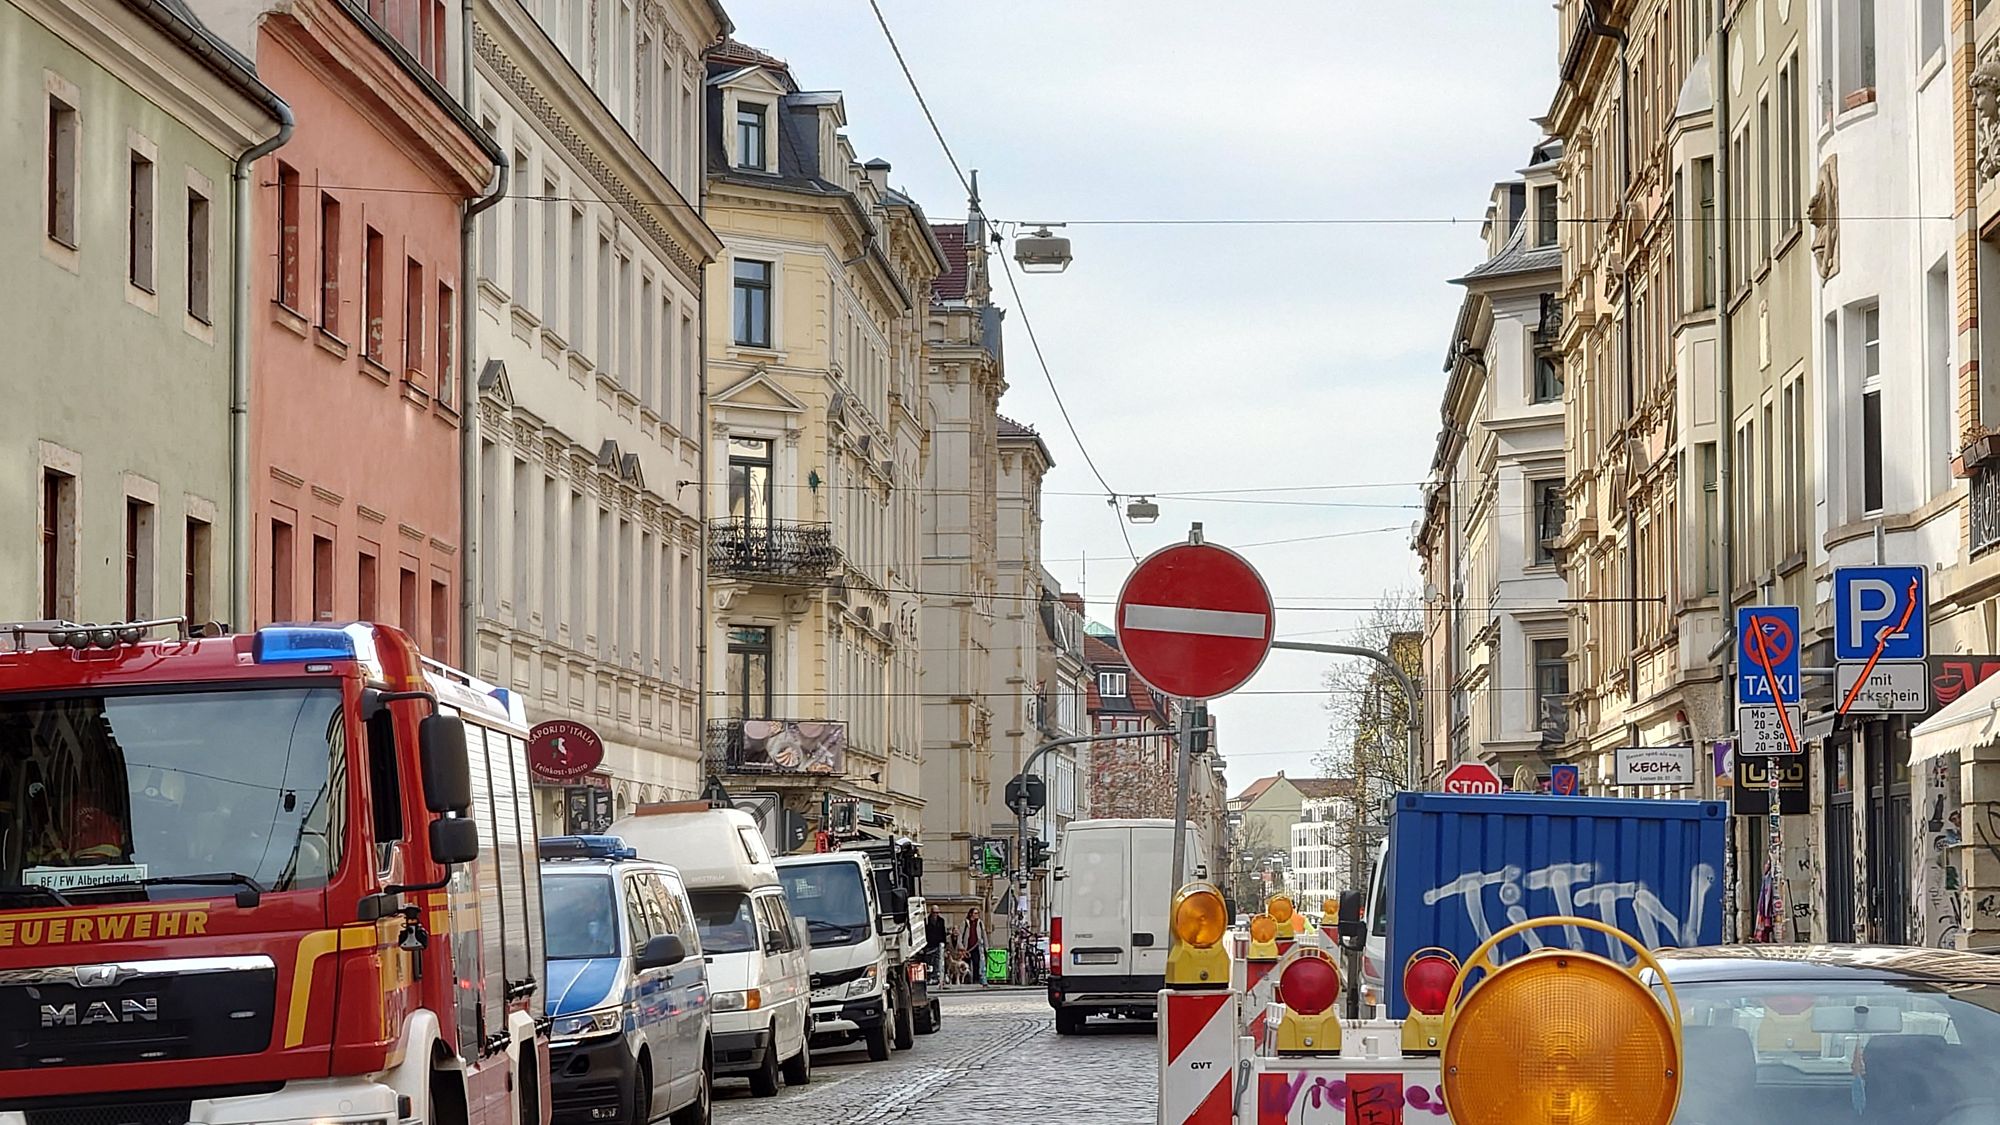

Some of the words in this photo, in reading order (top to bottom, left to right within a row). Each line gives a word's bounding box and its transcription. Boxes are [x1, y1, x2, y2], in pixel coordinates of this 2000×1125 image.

[1850, 579, 1896, 647] P
[1744, 675, 1793, 695] TAXI
[1870, 673, 1892, 686] mit
[1751, 710, 1766, 719] Mo
[1754, 720, 1765, 729] 20
[529, 725, 558, 745] SAPORI
[1755, 742, 1766, 751] 20
[535, 762, 565, 776] Feinkost
[567, 763, 588, 775] Bistro
[1629, 761, 1681, 774] KECHA
[1450, 780, 1496, 794] STOP
[78, 873, 130, 887] Albertstadt
[41, 997, 158, 1028] MAN
